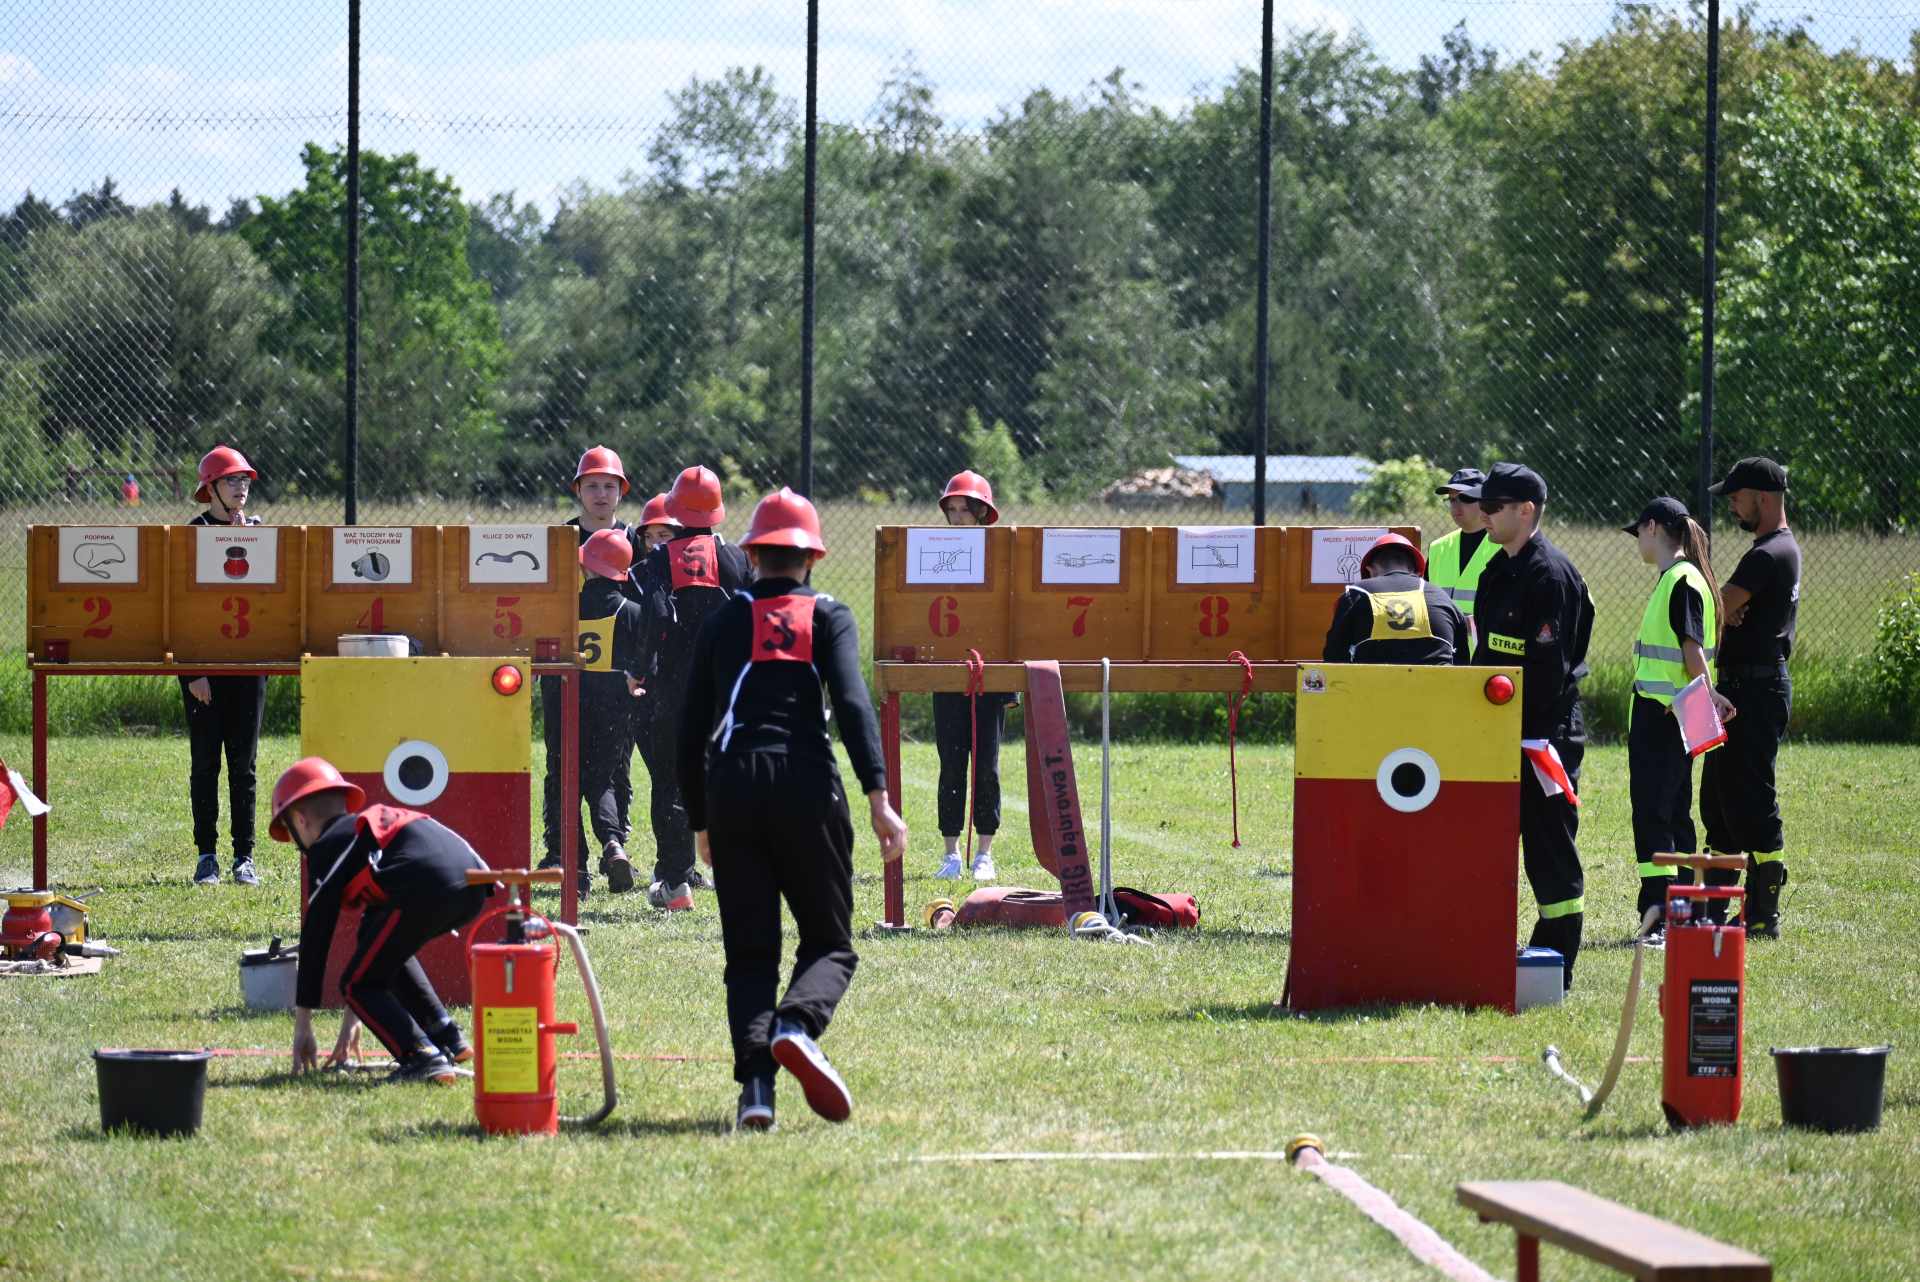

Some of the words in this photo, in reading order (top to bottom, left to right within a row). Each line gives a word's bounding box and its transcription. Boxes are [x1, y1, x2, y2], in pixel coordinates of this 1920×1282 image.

[83, 596, 113, 639] 2
[220, 596, 250, 639] 3
[355, 597, 388, 634] 4
[494, 596, 523, 639] 5
[762, 610, 796, 651] 3
[928, 595, 961, 638] 6
[1065, 596, 1095, 638] 7
[1199, 595, 1230, 638] 8
[1385, 599, 1415, 631] 9
[578, 632, 602, 664] 6
